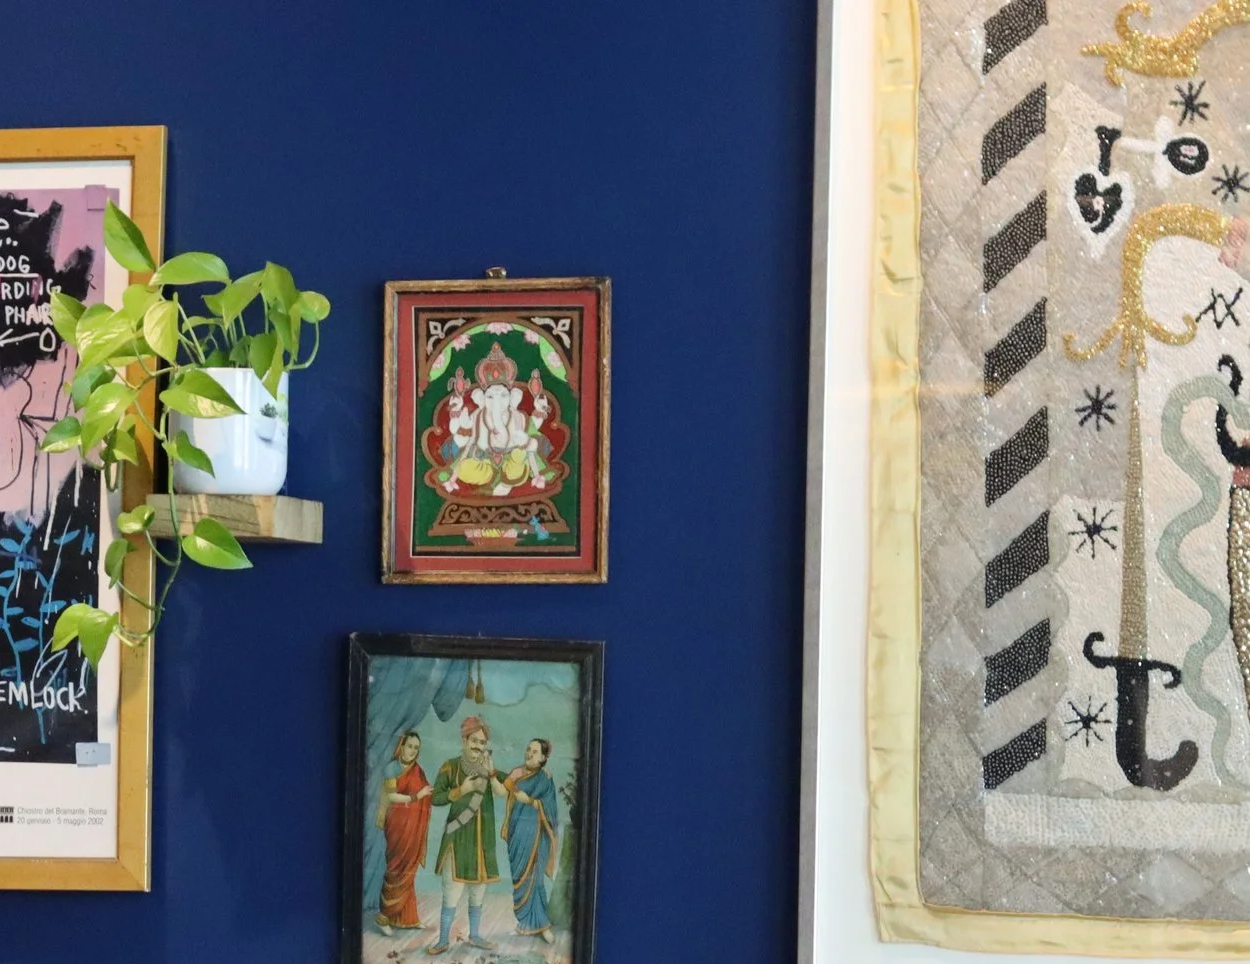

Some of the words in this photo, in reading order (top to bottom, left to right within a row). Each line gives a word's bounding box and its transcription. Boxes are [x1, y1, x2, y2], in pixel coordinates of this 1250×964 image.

[5, 302, 55, 326] PHAR
[16, 816, 26, 825] 20
[87, 817, 104, 826] 2002
